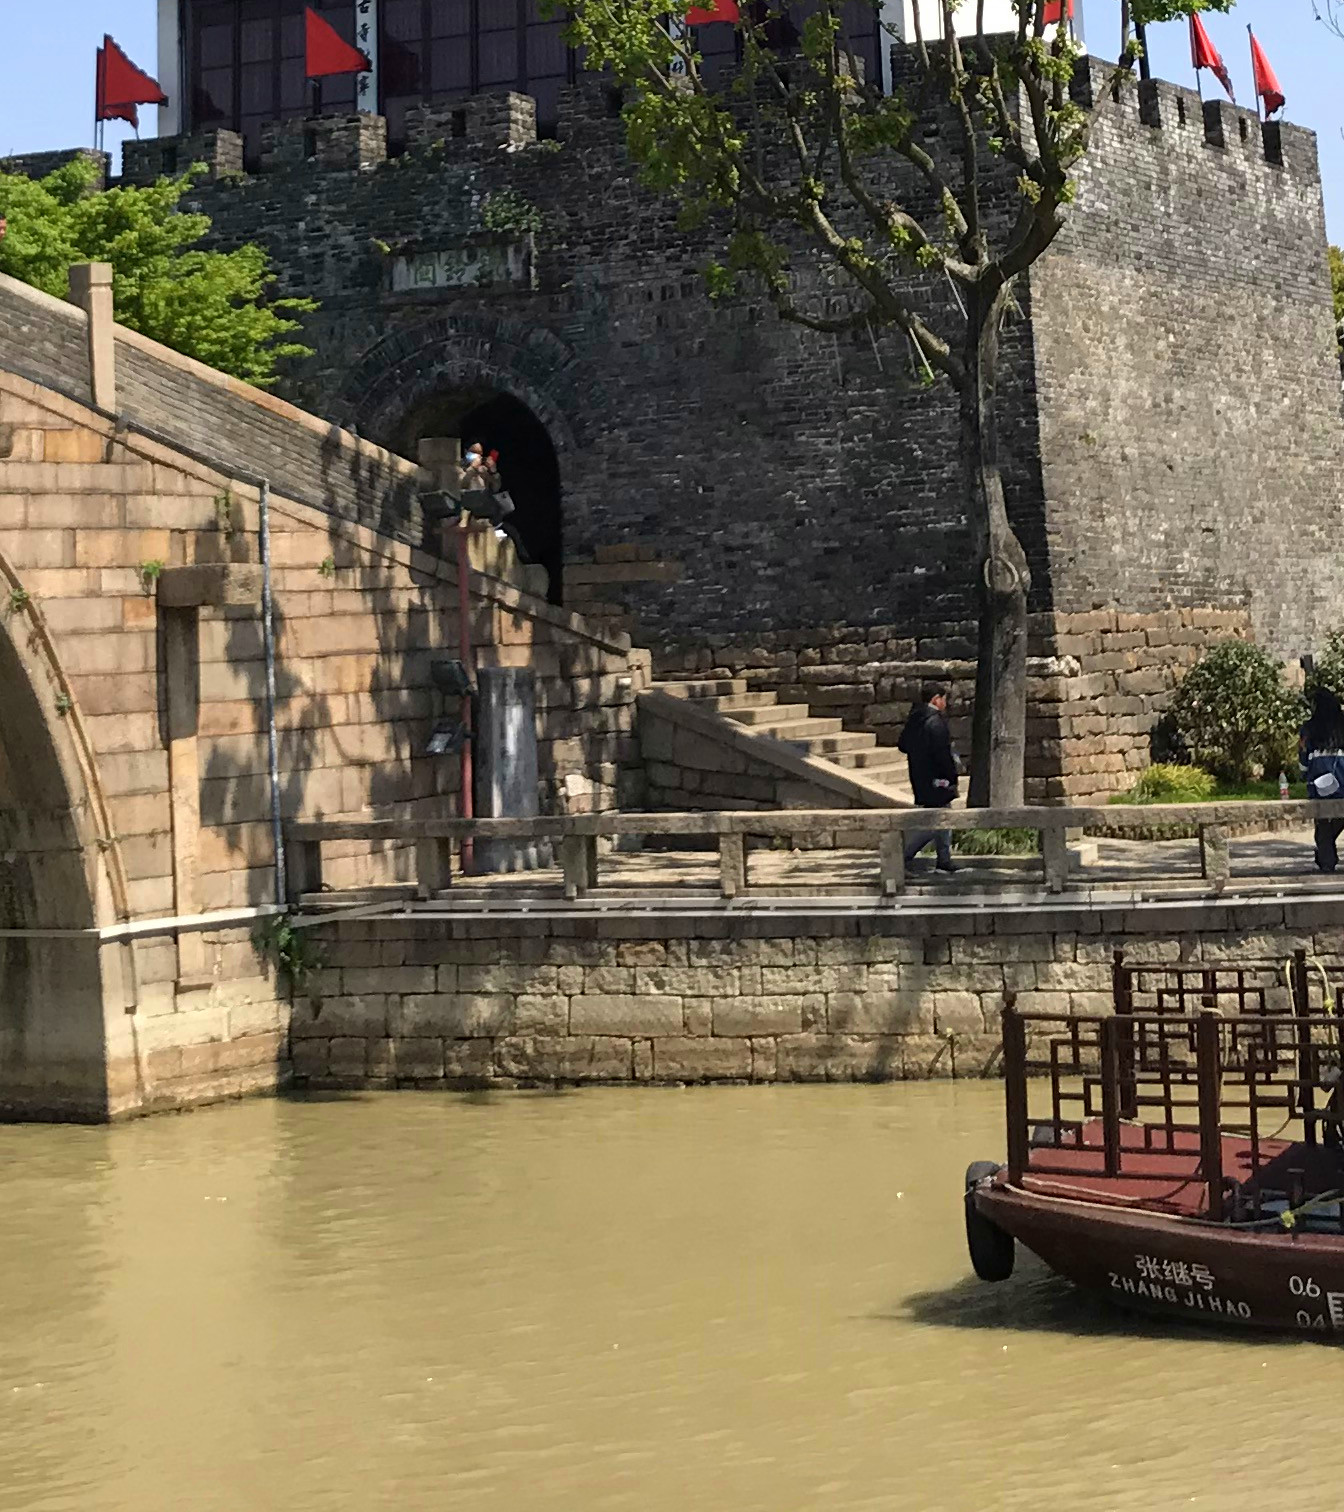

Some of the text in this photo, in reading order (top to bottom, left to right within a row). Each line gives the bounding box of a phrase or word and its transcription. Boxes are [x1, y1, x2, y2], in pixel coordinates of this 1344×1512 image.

[1134, 1254, 1215, 1290] 张继号
[1108, 1272, 1252, 1319] ZHANG JI HAO
